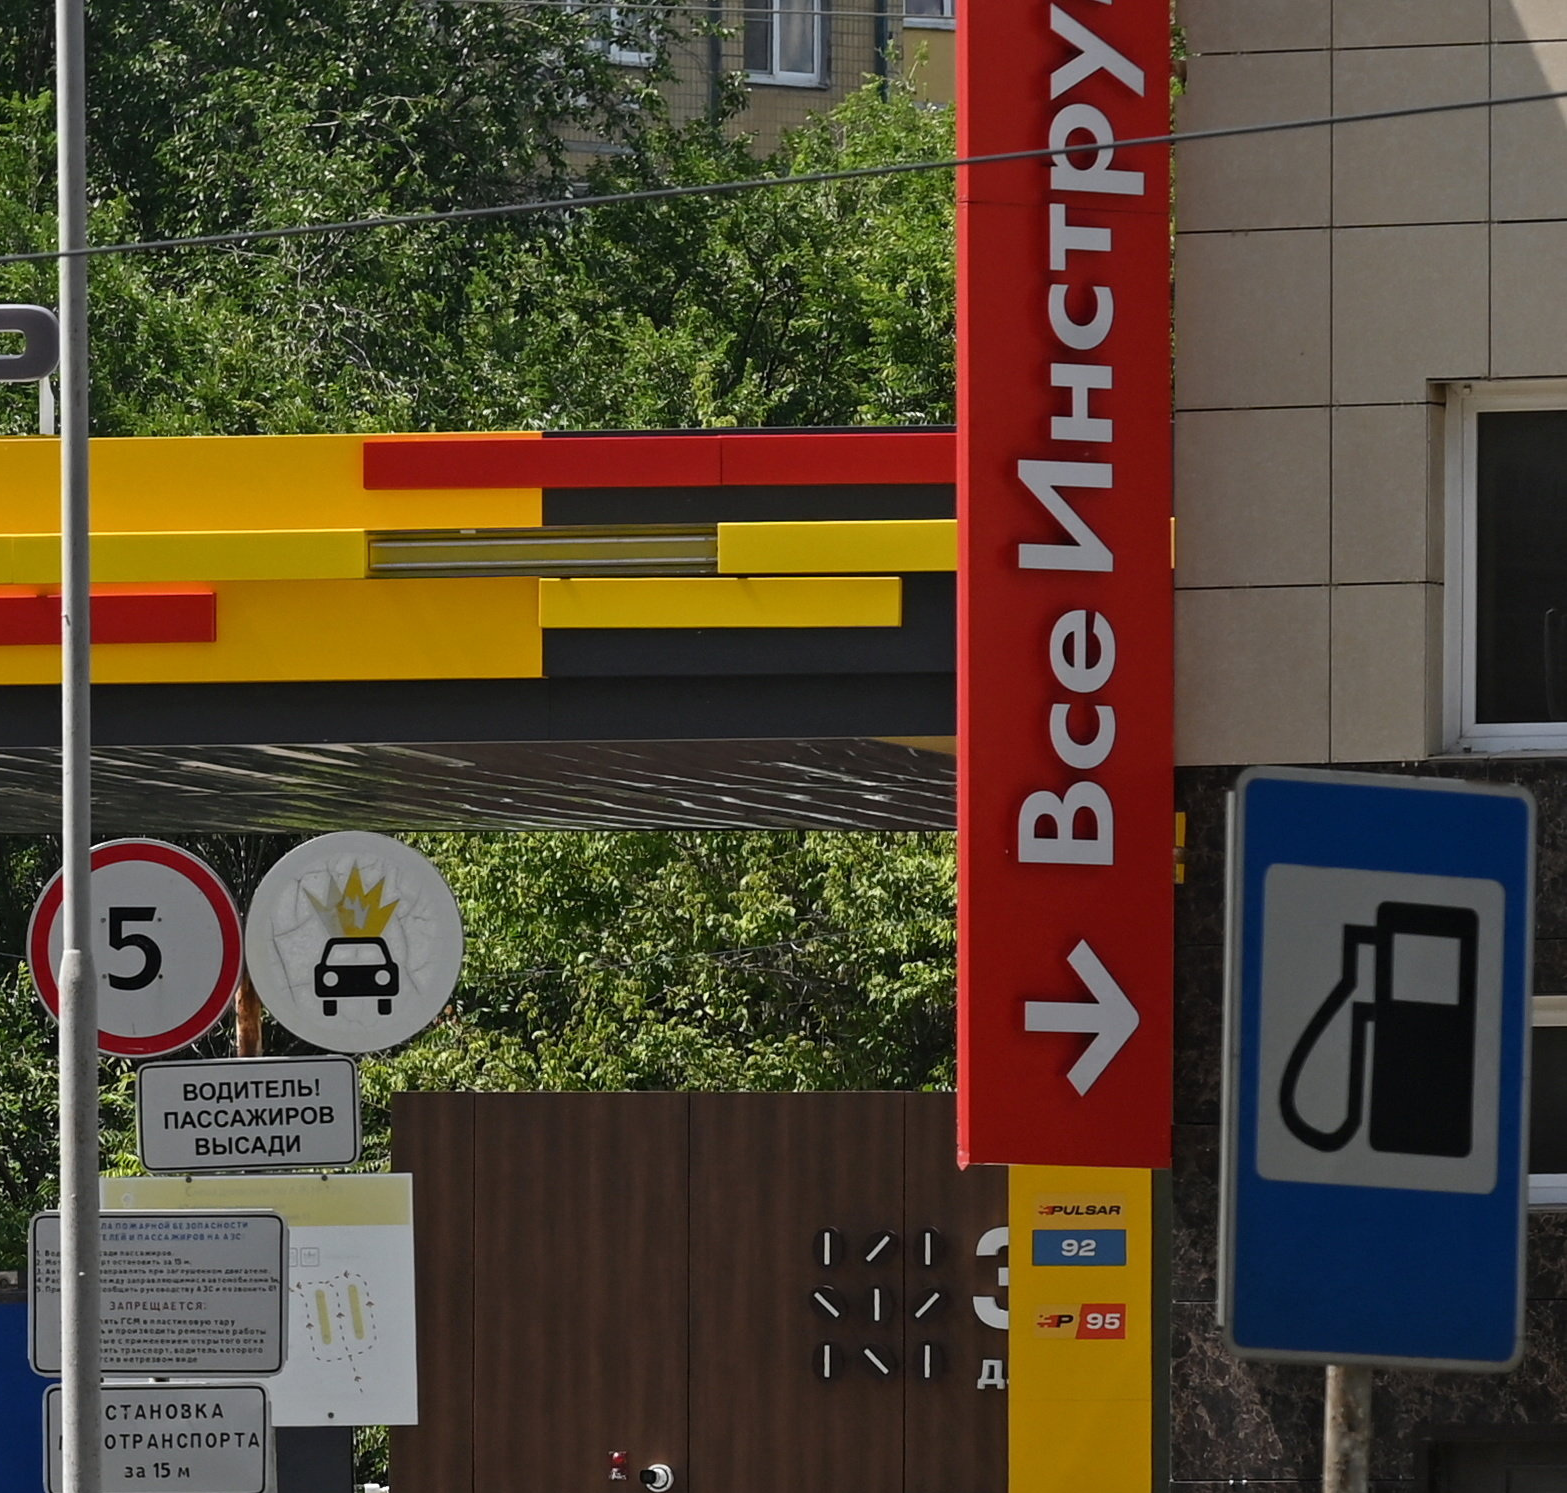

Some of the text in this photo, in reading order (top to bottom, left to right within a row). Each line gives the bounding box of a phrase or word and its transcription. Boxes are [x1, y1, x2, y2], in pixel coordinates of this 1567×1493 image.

[1017, 0, 1146, 866] Все Инстру
[108, 905, 162, 991] 5
[182, 1078, 321, 1104] ВОДИТЕЛЬ!
[163, 1106, 336, 1130] ПАССАЖИРОВ
[194, 1134, 302, 1157] ВЫСАДИ
[1051, 1205, 1122, 1216] PULSAR
[172, 1221, 249, 1230] БЕЗОПАСНОСТИ
[137, 1233, 205, 1241] ПАССАЖИРОВ
[207, 1233, 220, 1241] НА
[1061, 1238, 1097, 1257] 92
[1085, 1313, 1121, 1330] 95
[105, 1402, 224, 1421] СТАНОВКА
[59, 1432, 261, 1451] ОТРАНСПОРТА
[124, 1462, 191, 1479] за 15 м
